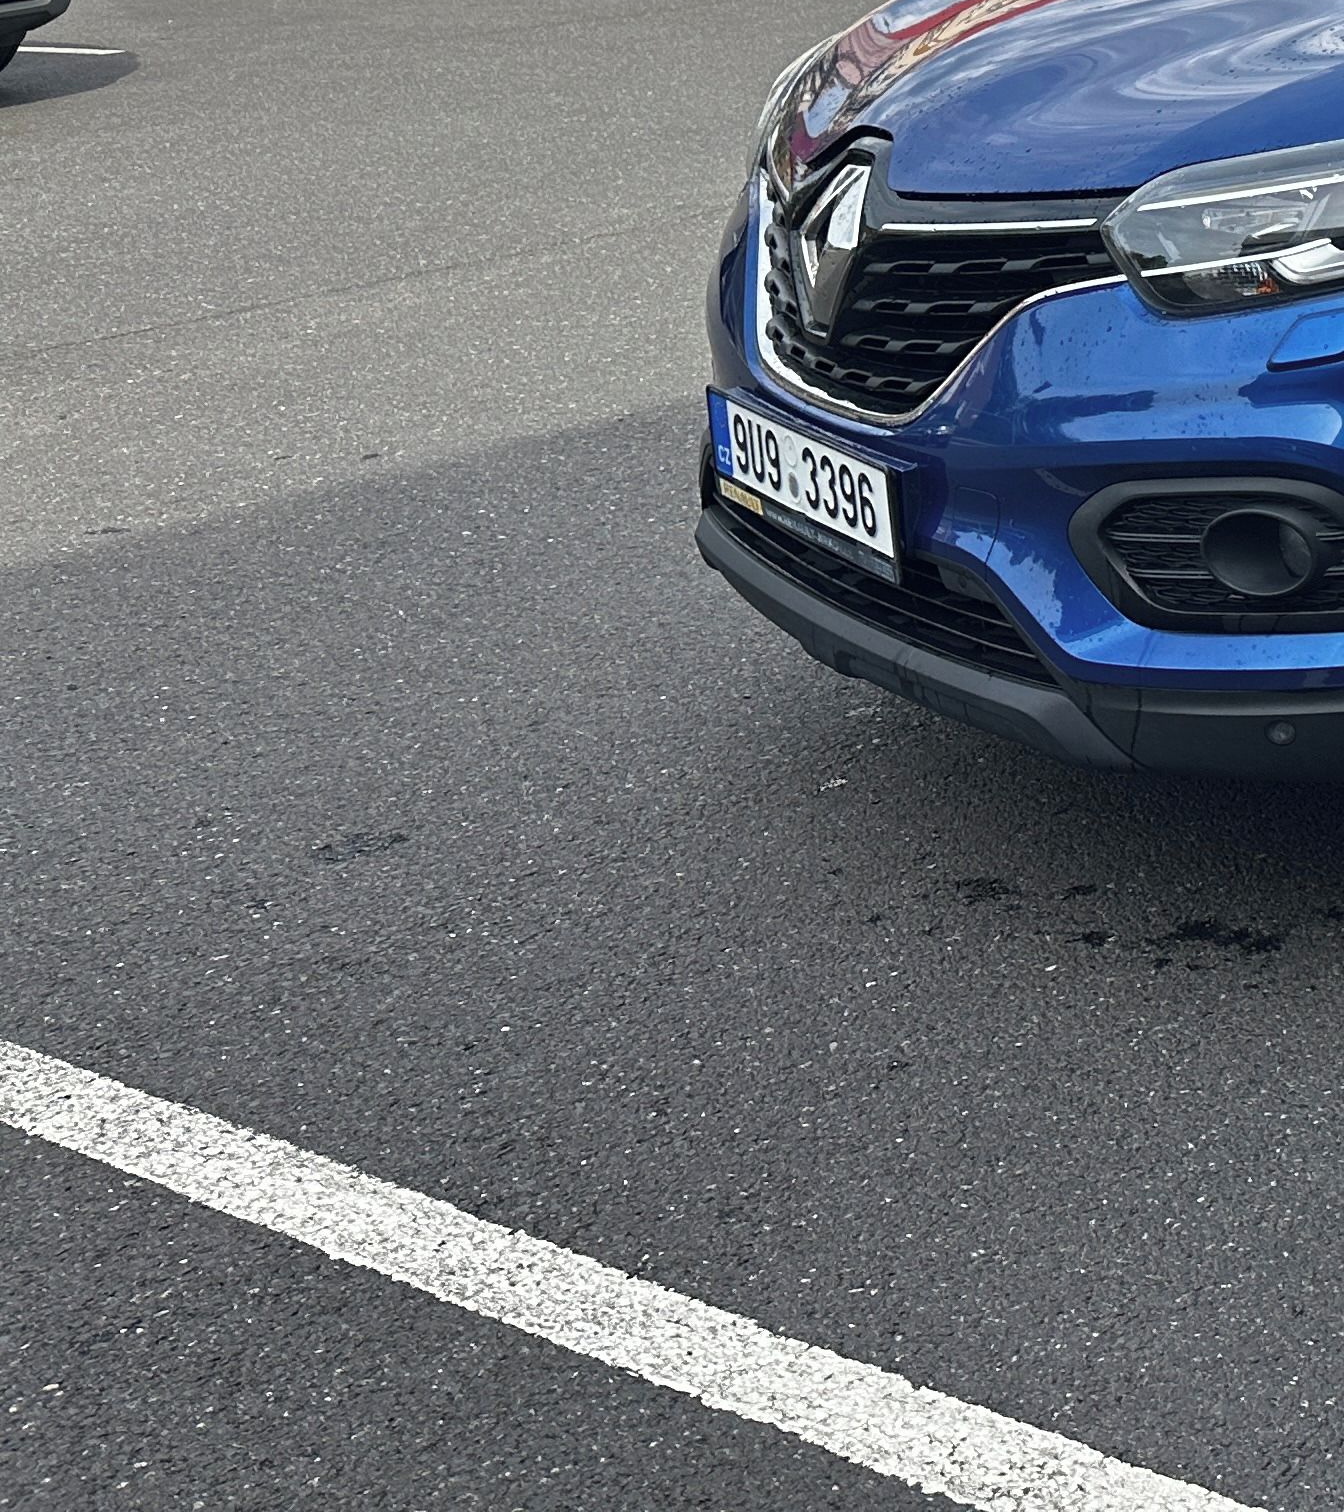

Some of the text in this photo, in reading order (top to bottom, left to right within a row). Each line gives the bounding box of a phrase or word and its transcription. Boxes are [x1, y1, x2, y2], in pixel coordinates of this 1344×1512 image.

[718, 444, 732, 466] CZ
[733, 413, 781, 492] 9U9
[802, 446, 878, 537] 3396
